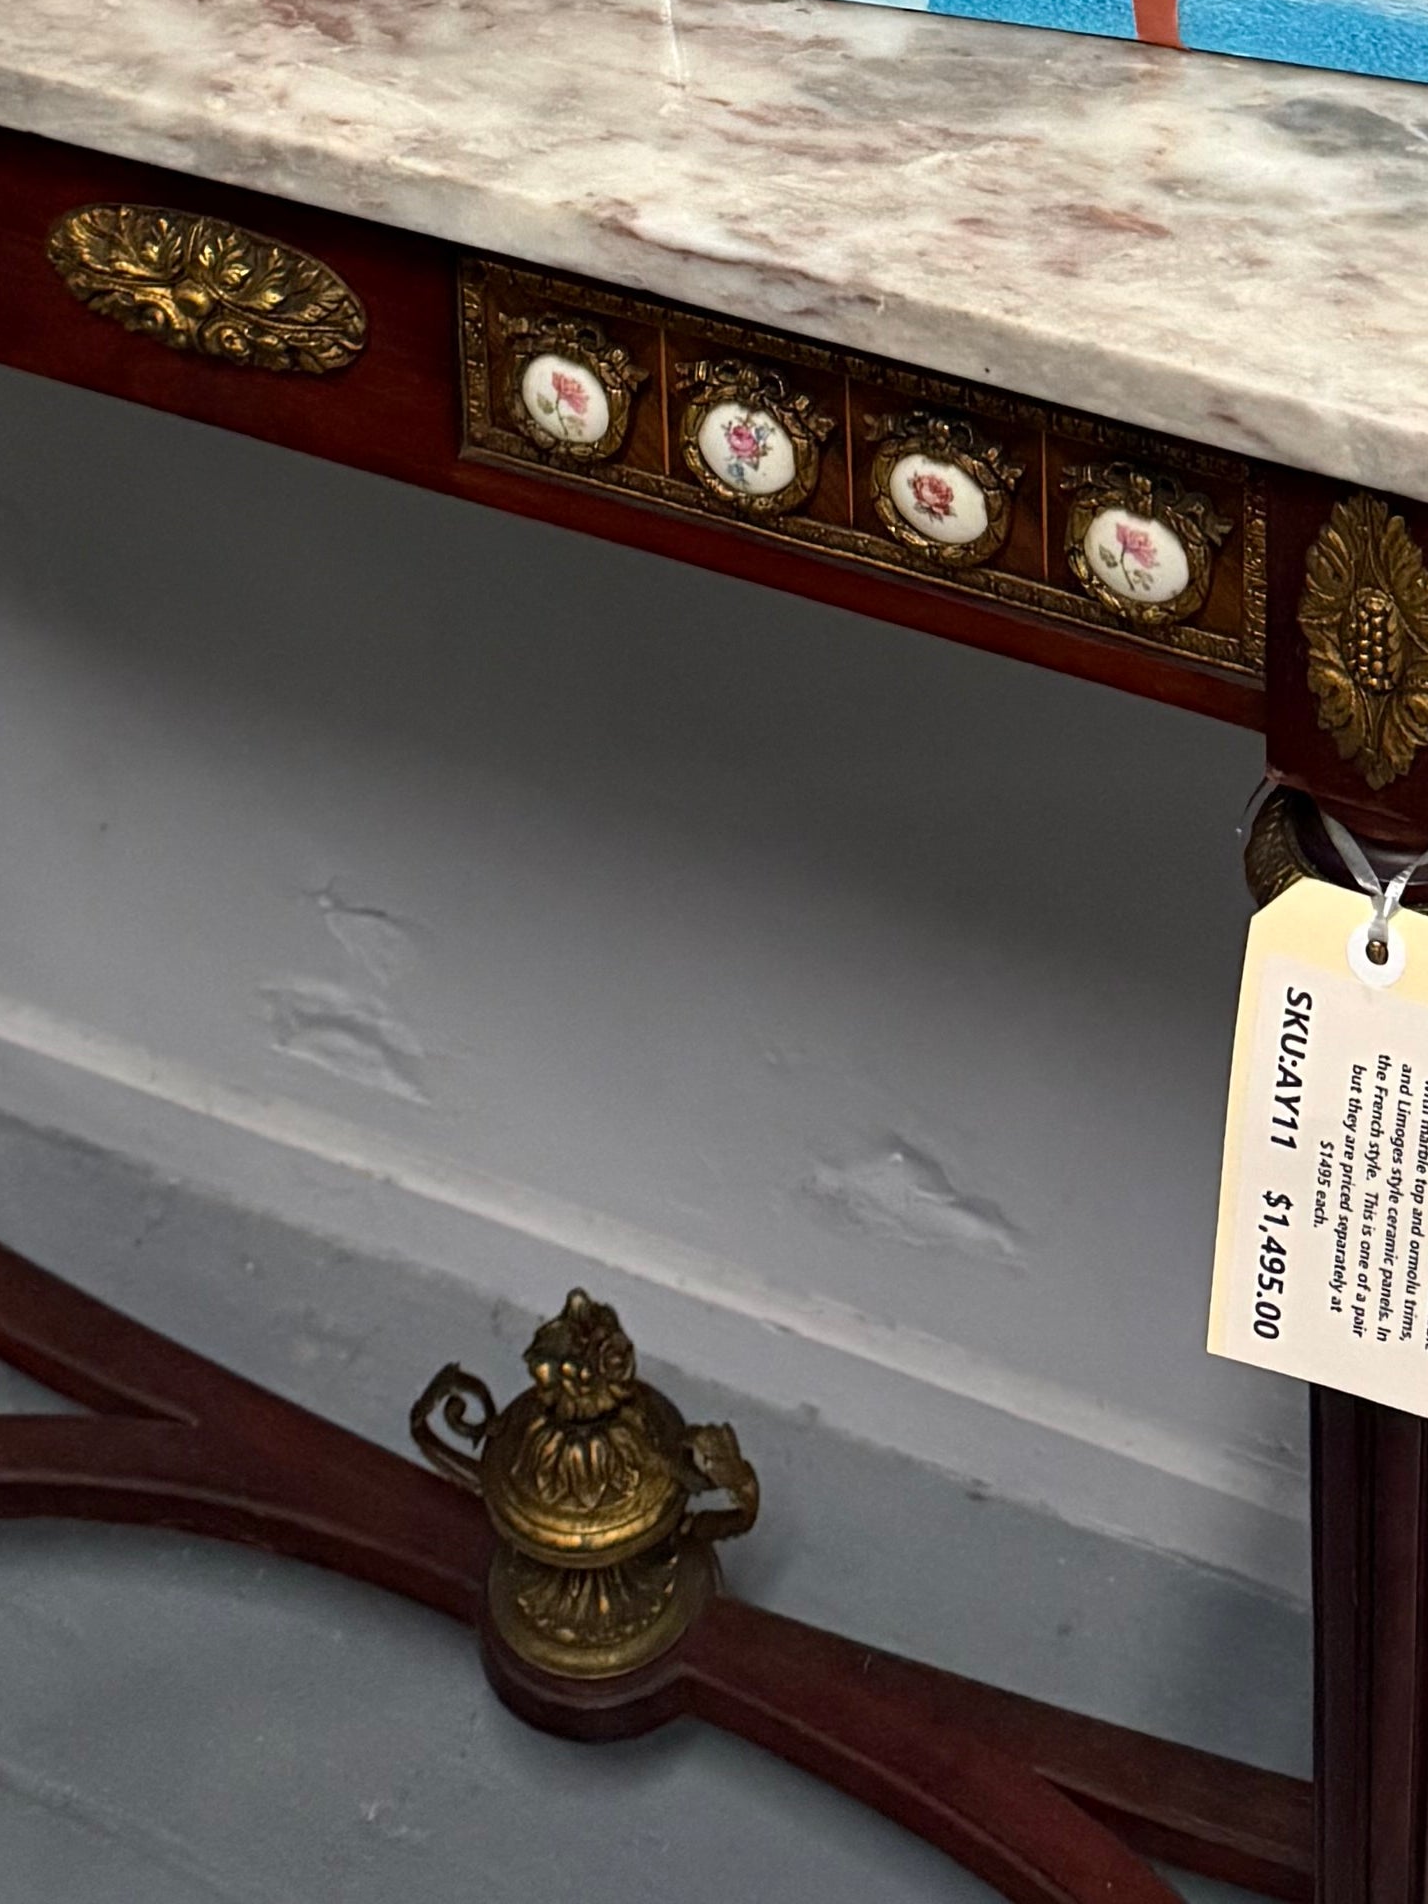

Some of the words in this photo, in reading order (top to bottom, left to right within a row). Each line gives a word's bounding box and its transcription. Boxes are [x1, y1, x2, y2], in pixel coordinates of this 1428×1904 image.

[1271, 986, 1312, 1150] SKU:AY11
[1352, 1064, 1367, 1093] but
[1343, 1097, 1362, 1132] they
[1371, 1086, 1388, 1138] French
[1390, 1098, 1411, 1165] Limoges
[1316, 1141, 1334, 1187] $1495
[1344, 1132, 1356, 1161] are
[1365, 1141, 1382, 1181] style.
[1340, 1163, 1353, 1211] priced
[1362, 1191, 1379, 1220] This
[1387, 1170, 1404, 1204] style
[1313, 1191, 1327, 1228] each.
[1329, 1214, 1350, 1293] separately
[1359, 1240, 1371, 1263] one
[1384, 1206, 1399, 1266] ceramic
[1253, 1191, 1294, 1339] $1,495.00
[1407, 1241, 1421, 1295] ormolu
[1379, 1267, 1396, 1322] panels.
[1352, 1306, 1366, 1338] pair
[1399, 1298, 1418, 1341] trims,
